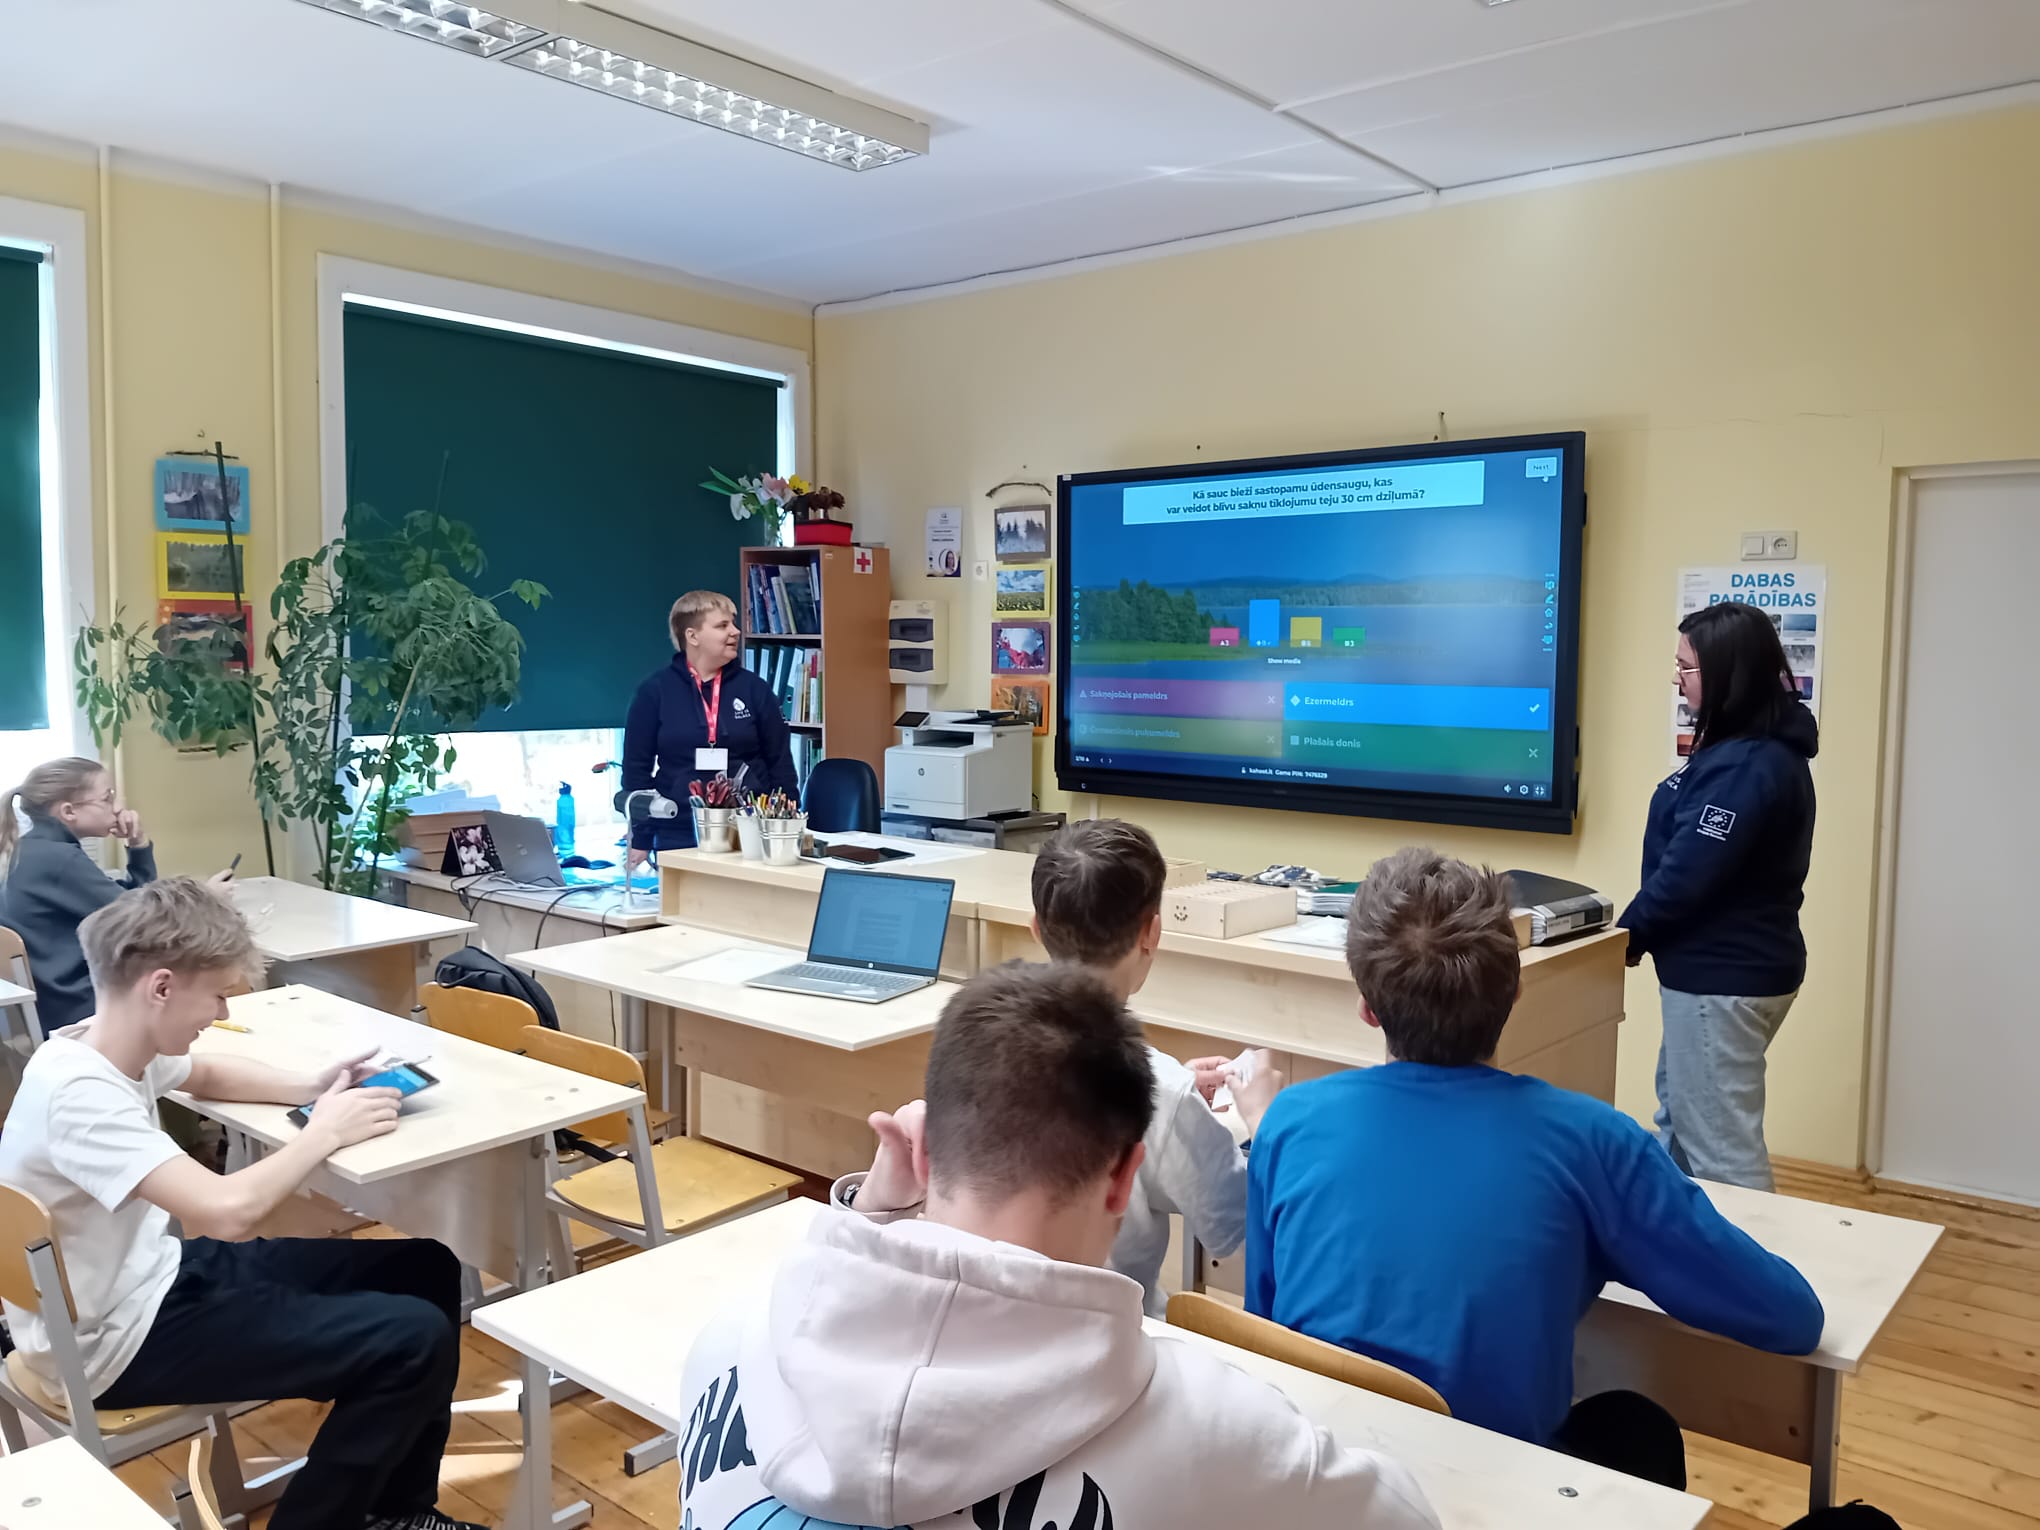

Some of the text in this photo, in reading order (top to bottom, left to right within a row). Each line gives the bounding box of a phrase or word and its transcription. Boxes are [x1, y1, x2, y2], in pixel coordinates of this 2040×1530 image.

[1193, 478, 1393, 500] Kā sauc bieži sastopamu ūdensaugu, kas
[1183, 503, 1211, 513] veidot
[1213, 501, 1236, 511] blīvu
[1238, 500, 1267, 511] sakņu
[1269, 496, 1316, 509] tīklojumu
[1319, 495, 1339, 506] teju
[1341, 495, 1354, 503] 30
[1375, 489, 1425, 504] dziļumā?
[1731, 573, 1795, 588] DABAS
[1709, 590, 1817, 608] PARĀDĪBAS
[1267, 657, 1302, 665] Show media
[1304, 696, 1354, 706] Ezermeldrs
[1304, 736, 1361, 748] Plašais donis
